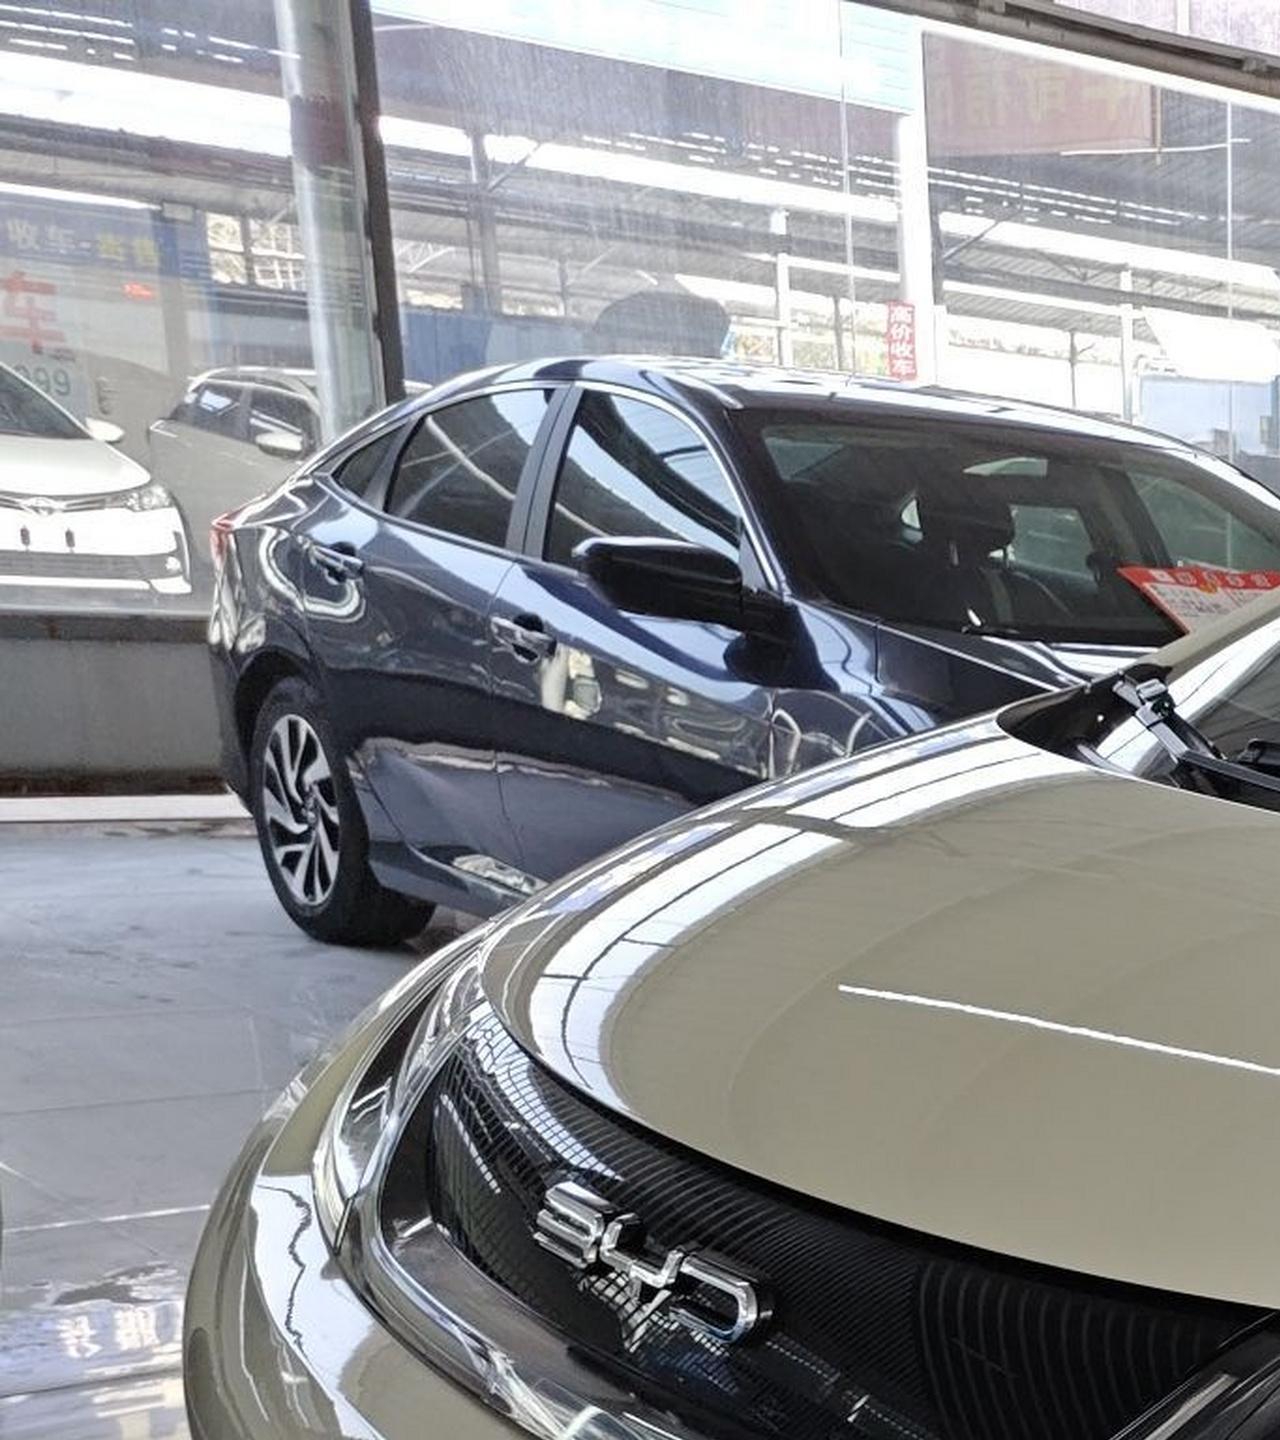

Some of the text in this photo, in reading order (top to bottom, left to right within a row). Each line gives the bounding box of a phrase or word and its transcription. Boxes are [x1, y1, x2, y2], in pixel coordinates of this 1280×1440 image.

[889, 305, 915, 376] 高价收车
[534, 1180, 758, 1352] BYD
